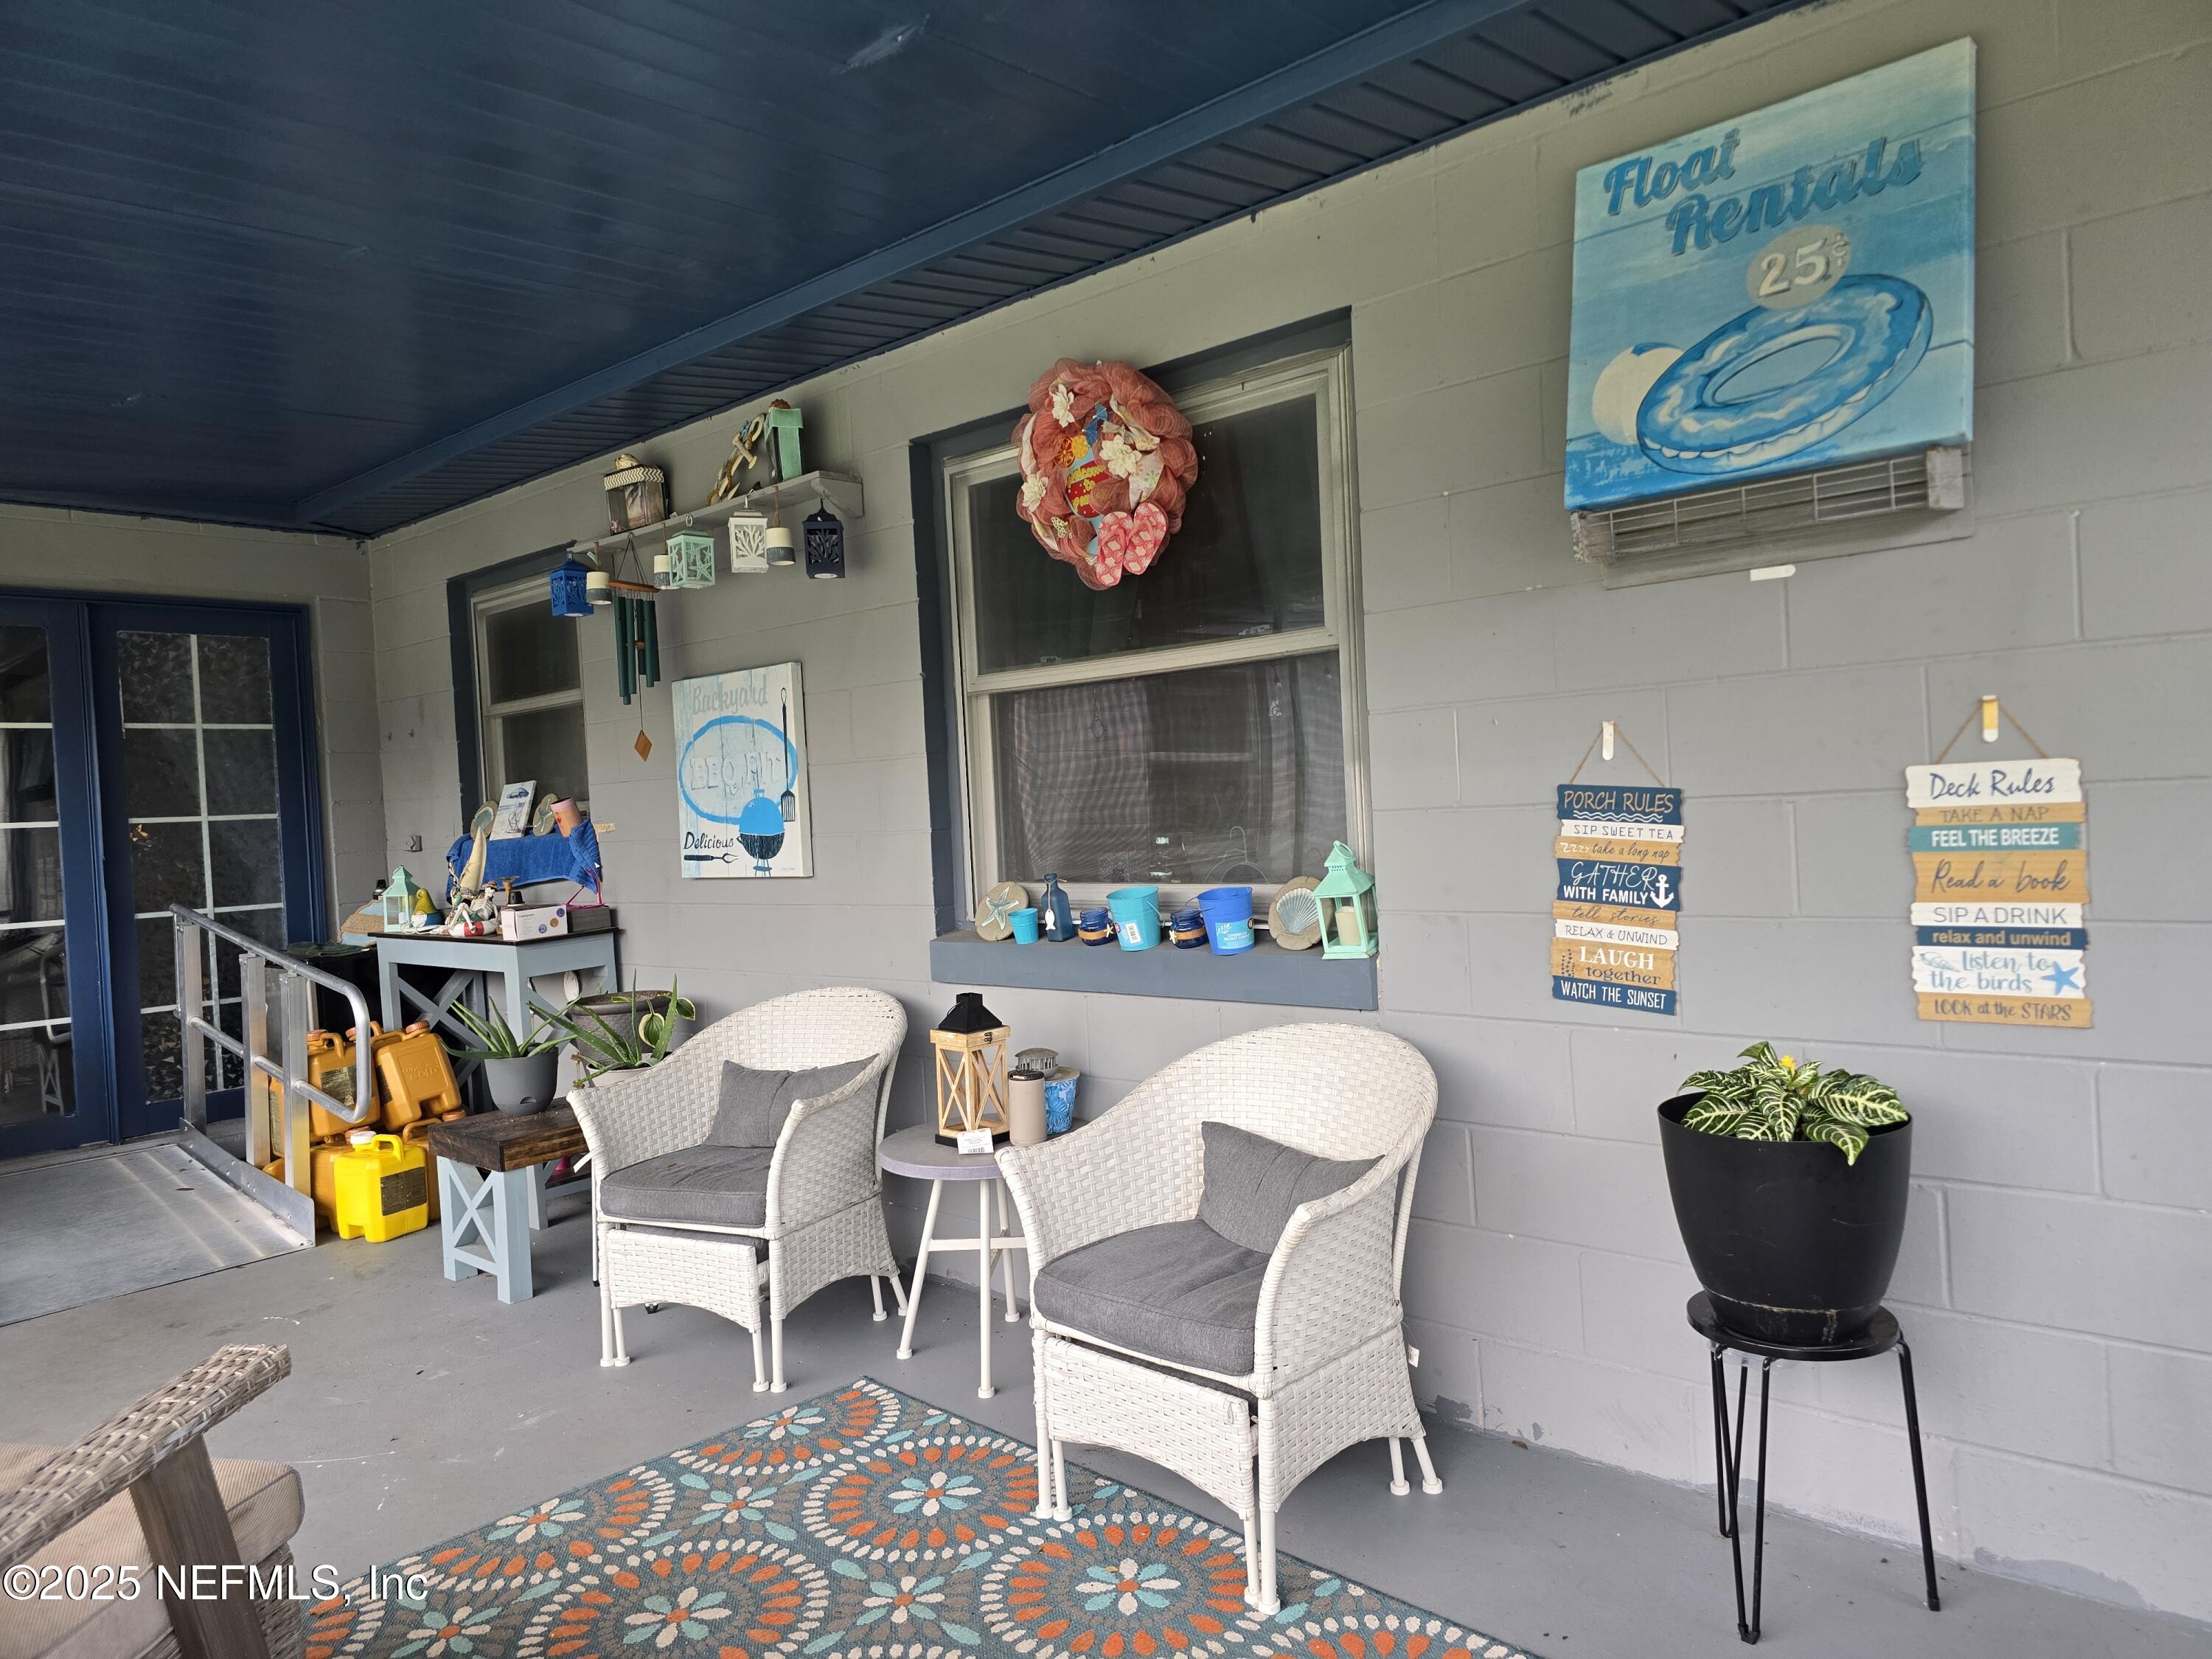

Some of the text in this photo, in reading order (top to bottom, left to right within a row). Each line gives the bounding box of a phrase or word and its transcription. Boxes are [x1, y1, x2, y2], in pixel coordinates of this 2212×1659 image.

[1603, 128, 1740, 216] Float
[1665, 136, 1923, 256] Rentals
[693, 673, 768, 715] Backyard
[1930, 768, 2055, 800] Deck Rules
[1564, 790, 1674, 813] PORCH RULES
[1939, 806, 2050, 824] TAKE A NAP
[684, 831, 734, 849] Delicious
[1573, 825, 1673, 840] SIP SWEET TEA
[1931, 827, 2059, 847] FEEL THE BREEZE
[1592, 841, 1615, 855] take
[1620, 846, 1624, 855] a
[1628, 843, 1649, 862] long
[1652, 850, 1670, 863] nap
[1571, 861, 1658, 891] GATHER
[1931, 858, 2070, 894] Read a book
[1564, 886, 1648, 905] WITH FAMILY
[1572, 906, 1660, 926] tell stories
[1933, 907, 2067, 924] SIP A DRINK
[1565, 925, 1667, 945] RELAX & UNWIND
[1933, 930, 2071, 946] relax and unwind
[1579, 947, 1655, 970] LAUGH
[2025, 952, 2053, 971] to
[1586, 967, 1661, 985] together
[1929, 970, 2032, 992] the birds
[1561, 980, 1666, 1009] WATCH THE SUNSET
[1935, 998, 2072, 1021] LOOK at the STARS
